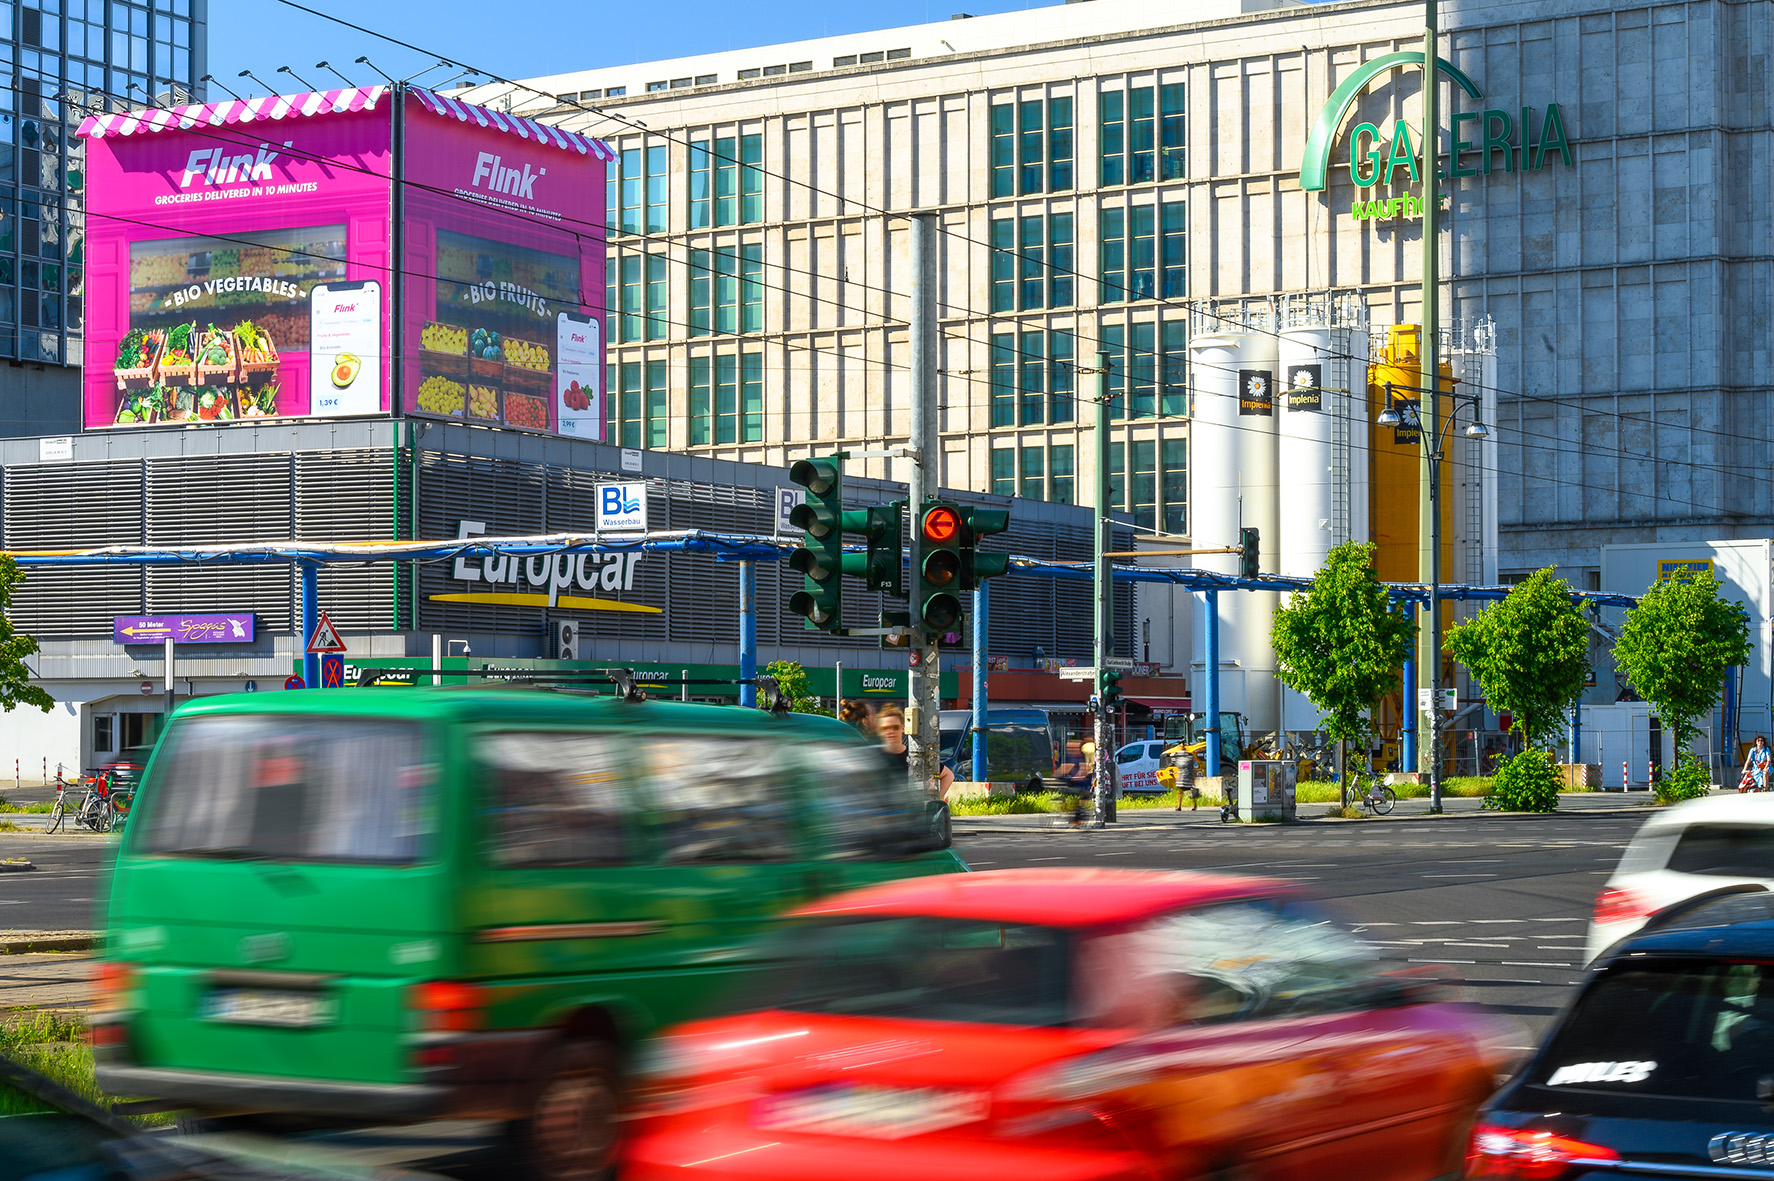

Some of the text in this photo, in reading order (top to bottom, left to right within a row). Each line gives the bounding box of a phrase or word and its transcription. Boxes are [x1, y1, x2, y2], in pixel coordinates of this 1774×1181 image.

[1350, 102, 1572, 189] GAERIA
[180, 143, 279, 187] Flink
[472, 151, 538, 200] Flink
[155, 182, 318, 205] GROCERIES DELIVERED IN 10 MINUTES
[1352, 191, 1446, 221] KAUFh
[334, 303, 356, 313] Flink
[319, 399, 333, 407] 1,39
[1287, 394, 1320, 406] Implenia
[602, 518, 641, 526] Wasserbau
[628, 667, 669, 681] uropcar
[863, 674, 896, 690] Europcar
